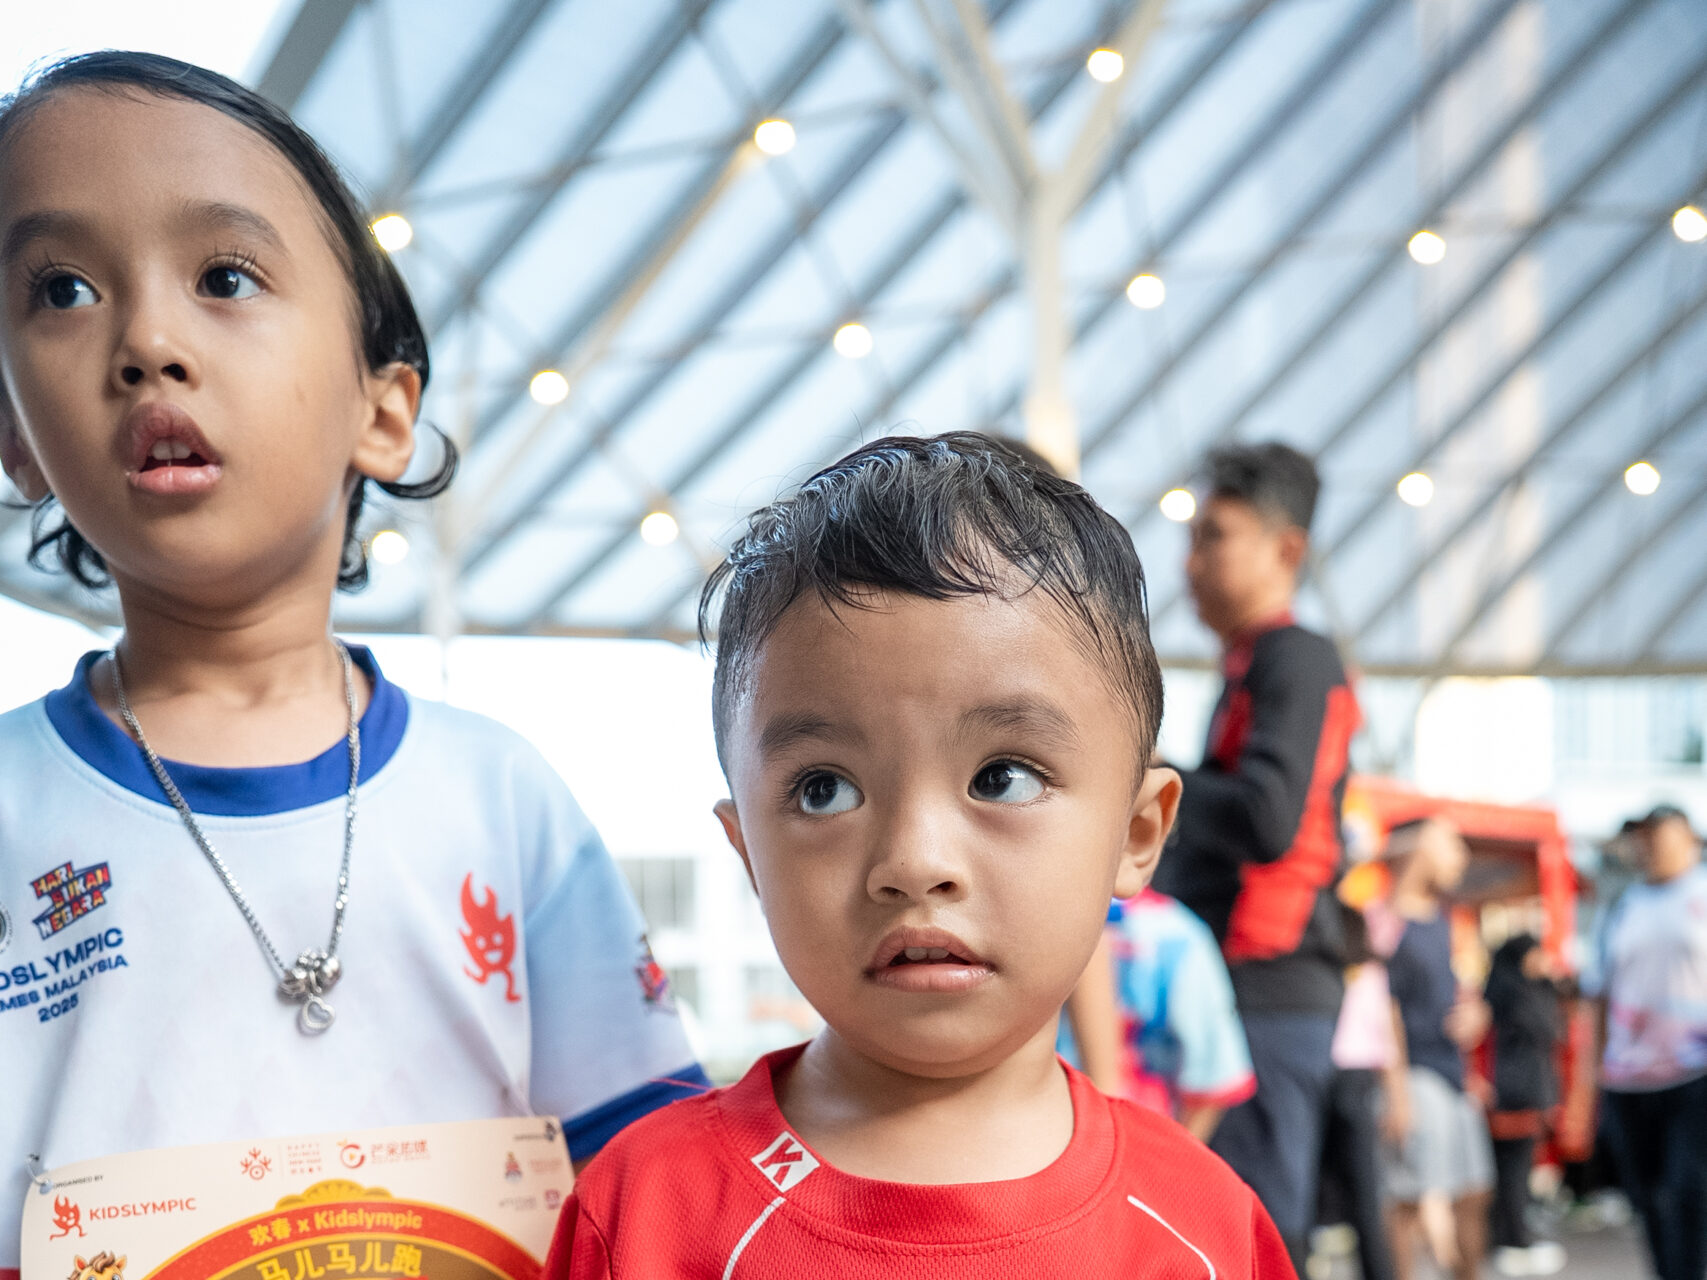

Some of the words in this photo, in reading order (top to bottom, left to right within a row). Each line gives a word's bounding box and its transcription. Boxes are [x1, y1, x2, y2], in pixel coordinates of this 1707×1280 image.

[45, 954, 128, 1000] MALAYSIA
[38, 992, 79, 1023] 2025
[89, 1198, 197, 1221] KIDSLYMPIC
[297, 1218, 310, 1233] x
[313, 1208, 423, 1230] Kidslympic
